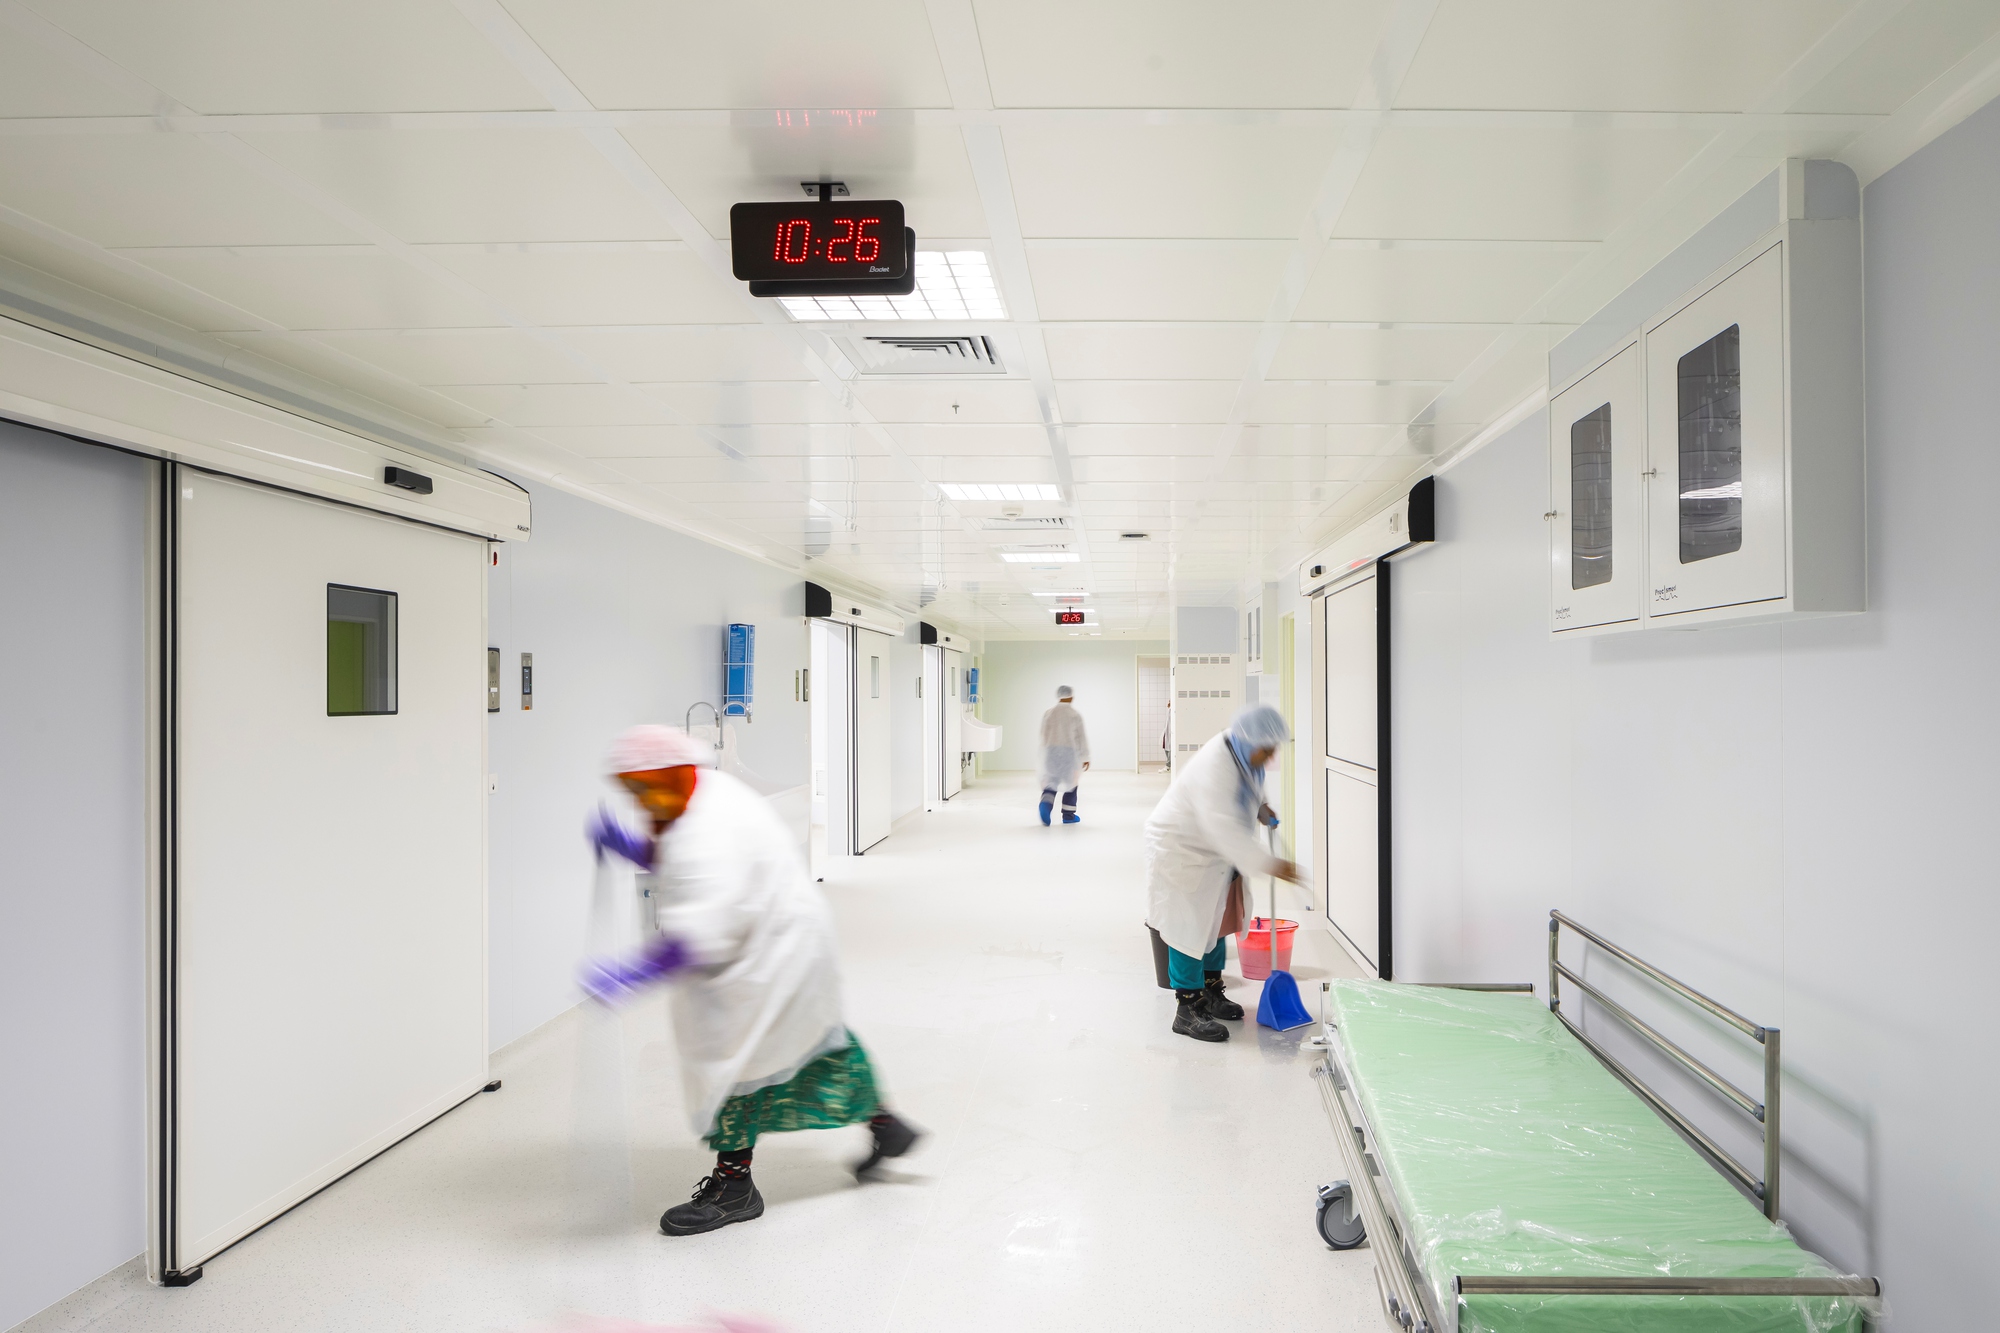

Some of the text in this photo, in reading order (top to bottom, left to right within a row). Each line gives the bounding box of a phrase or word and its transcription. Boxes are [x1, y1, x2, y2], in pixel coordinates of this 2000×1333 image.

[774, 217, 881, 263] 10:26
[869, 265, 890, 273] Bodet
[1062, 613, 1081, 622] 10:26
